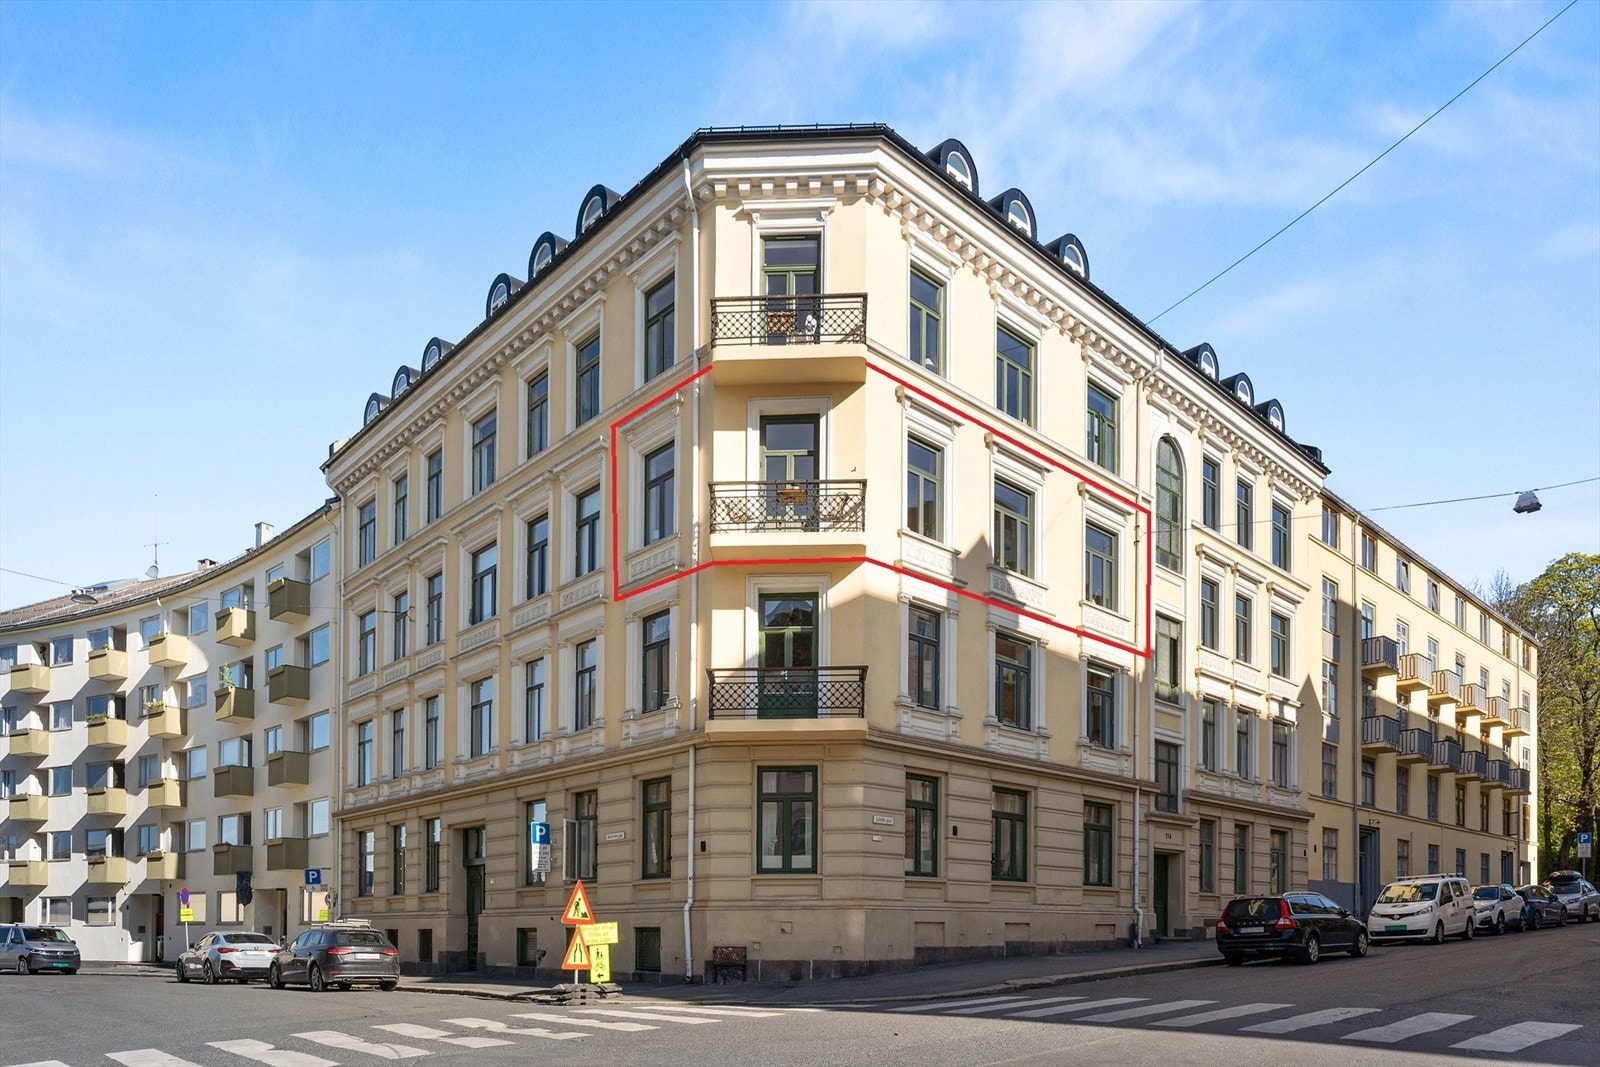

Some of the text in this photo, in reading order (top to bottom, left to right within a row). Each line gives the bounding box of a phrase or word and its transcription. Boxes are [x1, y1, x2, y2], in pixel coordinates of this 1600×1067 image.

[536, 825, 546, 842] P
[1580, 834, 1588, 842] P
[309, 871, 317, 882] P
